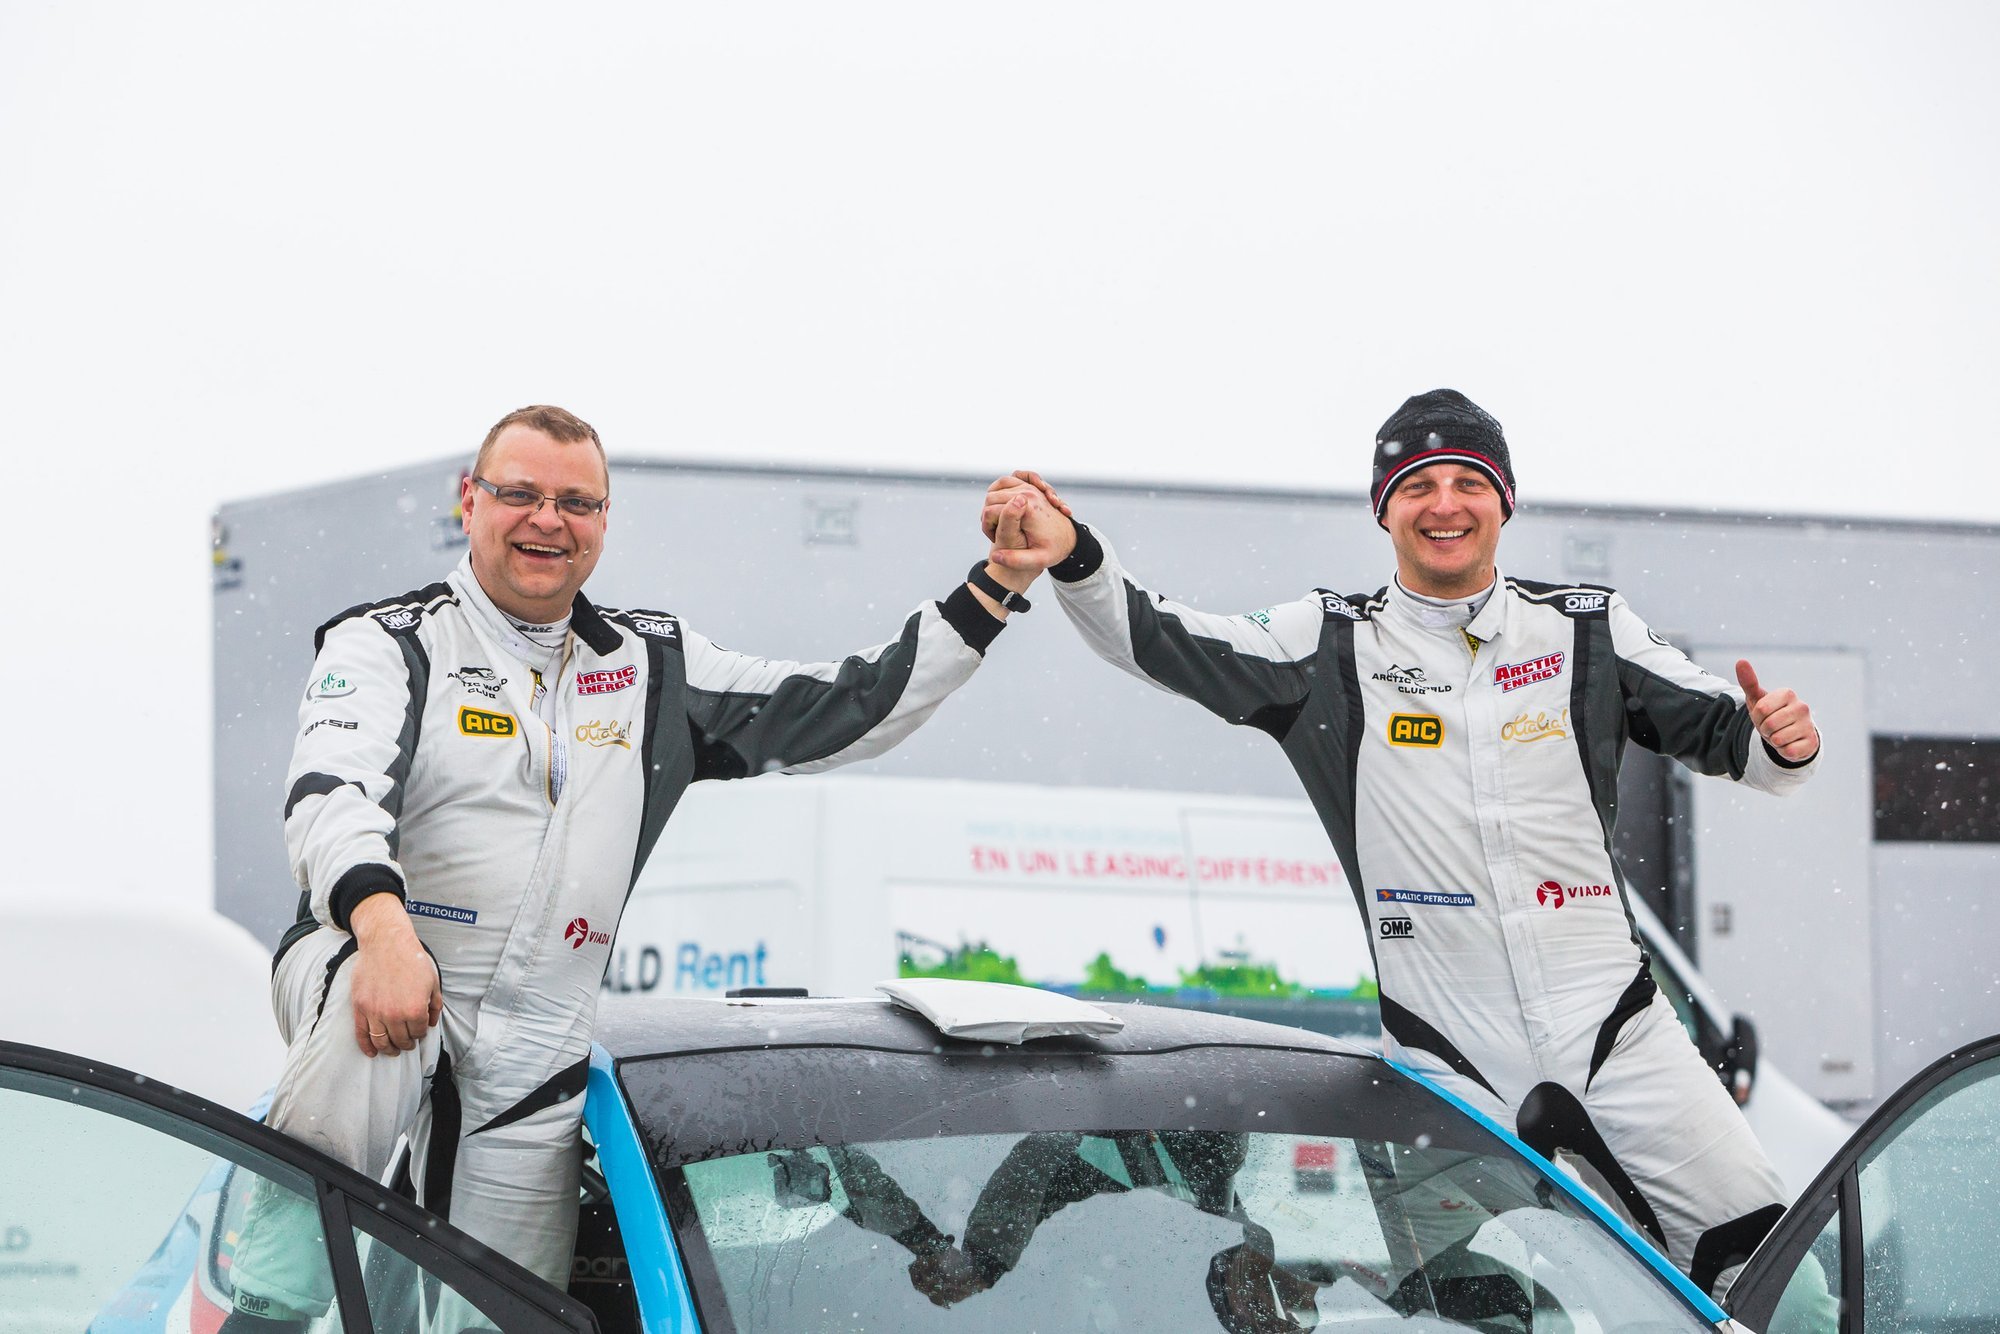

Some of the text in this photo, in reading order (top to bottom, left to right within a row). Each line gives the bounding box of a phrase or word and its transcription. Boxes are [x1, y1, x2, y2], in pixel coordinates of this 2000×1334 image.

[1565, 596, 1605, 610] OMP
[381, 611, 414, 629] OMP
[635, 620, 675, 636] OMP
[575, 665, 636, 685] ARCTIC
[1494, 653, 1564, 684] ARCTIC
[577, 677, 636, 695] ENERGY
[1371, 672, 1412, 684] ARCTIC
[1503, 664, 1563, 692] ENERGY
[465, 713, 509, 733] AIC
[1395, 719, 1437, 741] AIC
[971, 846, 1009, 872] EN
[1018, 848, 1058, 873] UN
[1068, 850, 1189, 880] LEASING
[1395, 892, 1473, 905] BALTIC PETROLEUM
[1567, 885, 1612, 898] VIADA
[419, 905, 474, 922] PETROLEUM
[1380, 920, 1413, 936] OMP
[588, 930, 611, 946] VIADA
[675, 939, 767, 991] Rent
[240, 1294, 270, 1312] OMP
